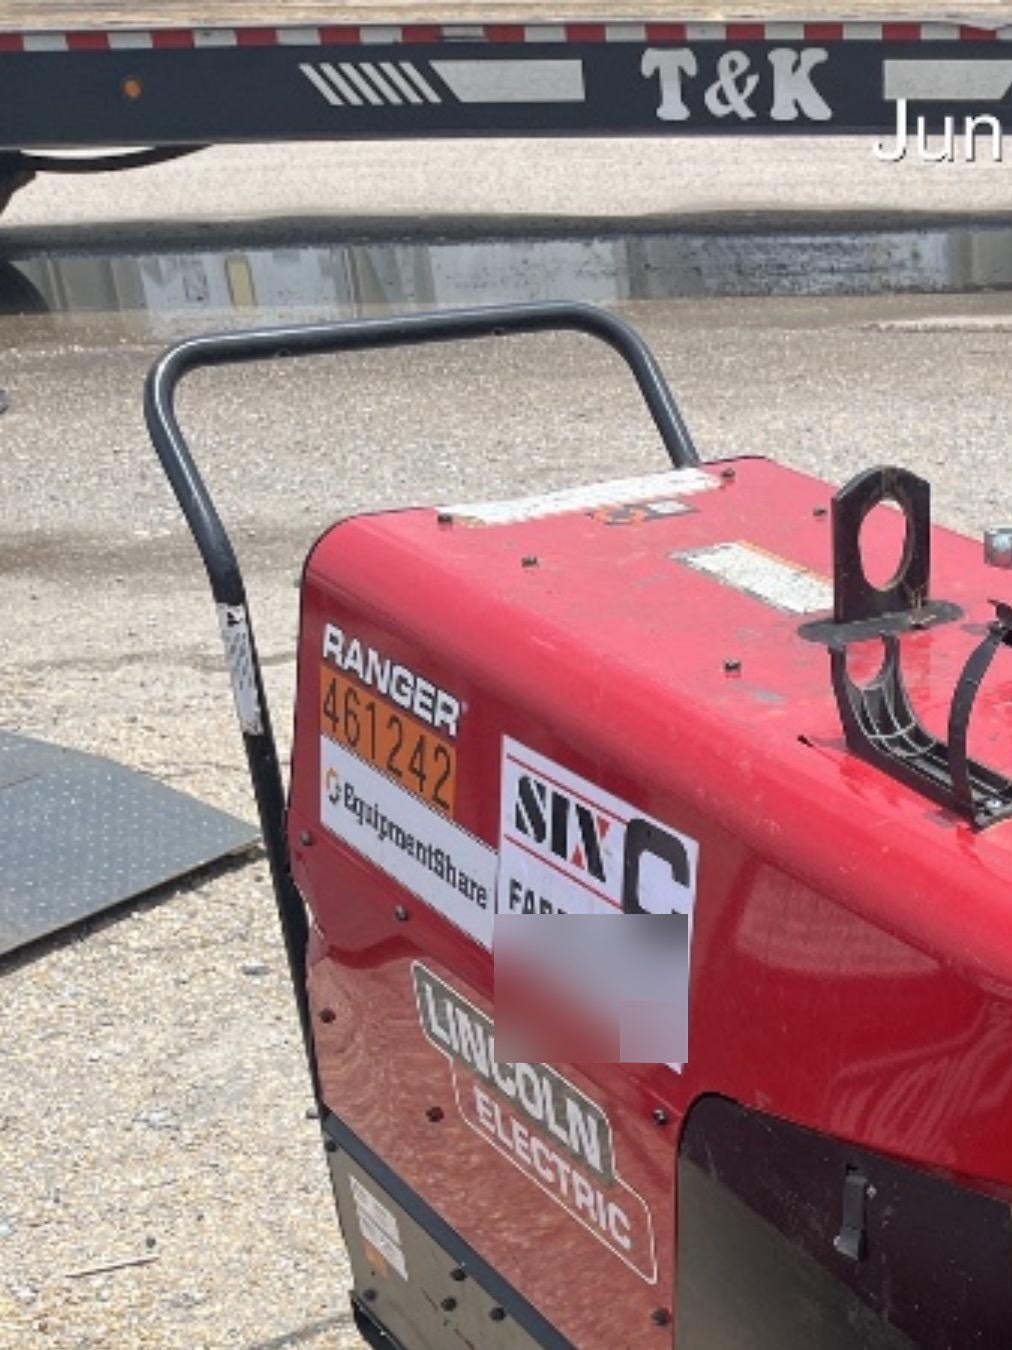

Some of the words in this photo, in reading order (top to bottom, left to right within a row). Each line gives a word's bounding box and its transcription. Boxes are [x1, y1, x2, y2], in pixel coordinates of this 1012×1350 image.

[641, 47, 833, 121] T&K
[322, 622, 458, 737] RANGER
[323, 676, 451, 811] 461242
[344, 780, 488, 911] EquipmentShare
[473, 1085, 633, 1250] ELECTRIC
